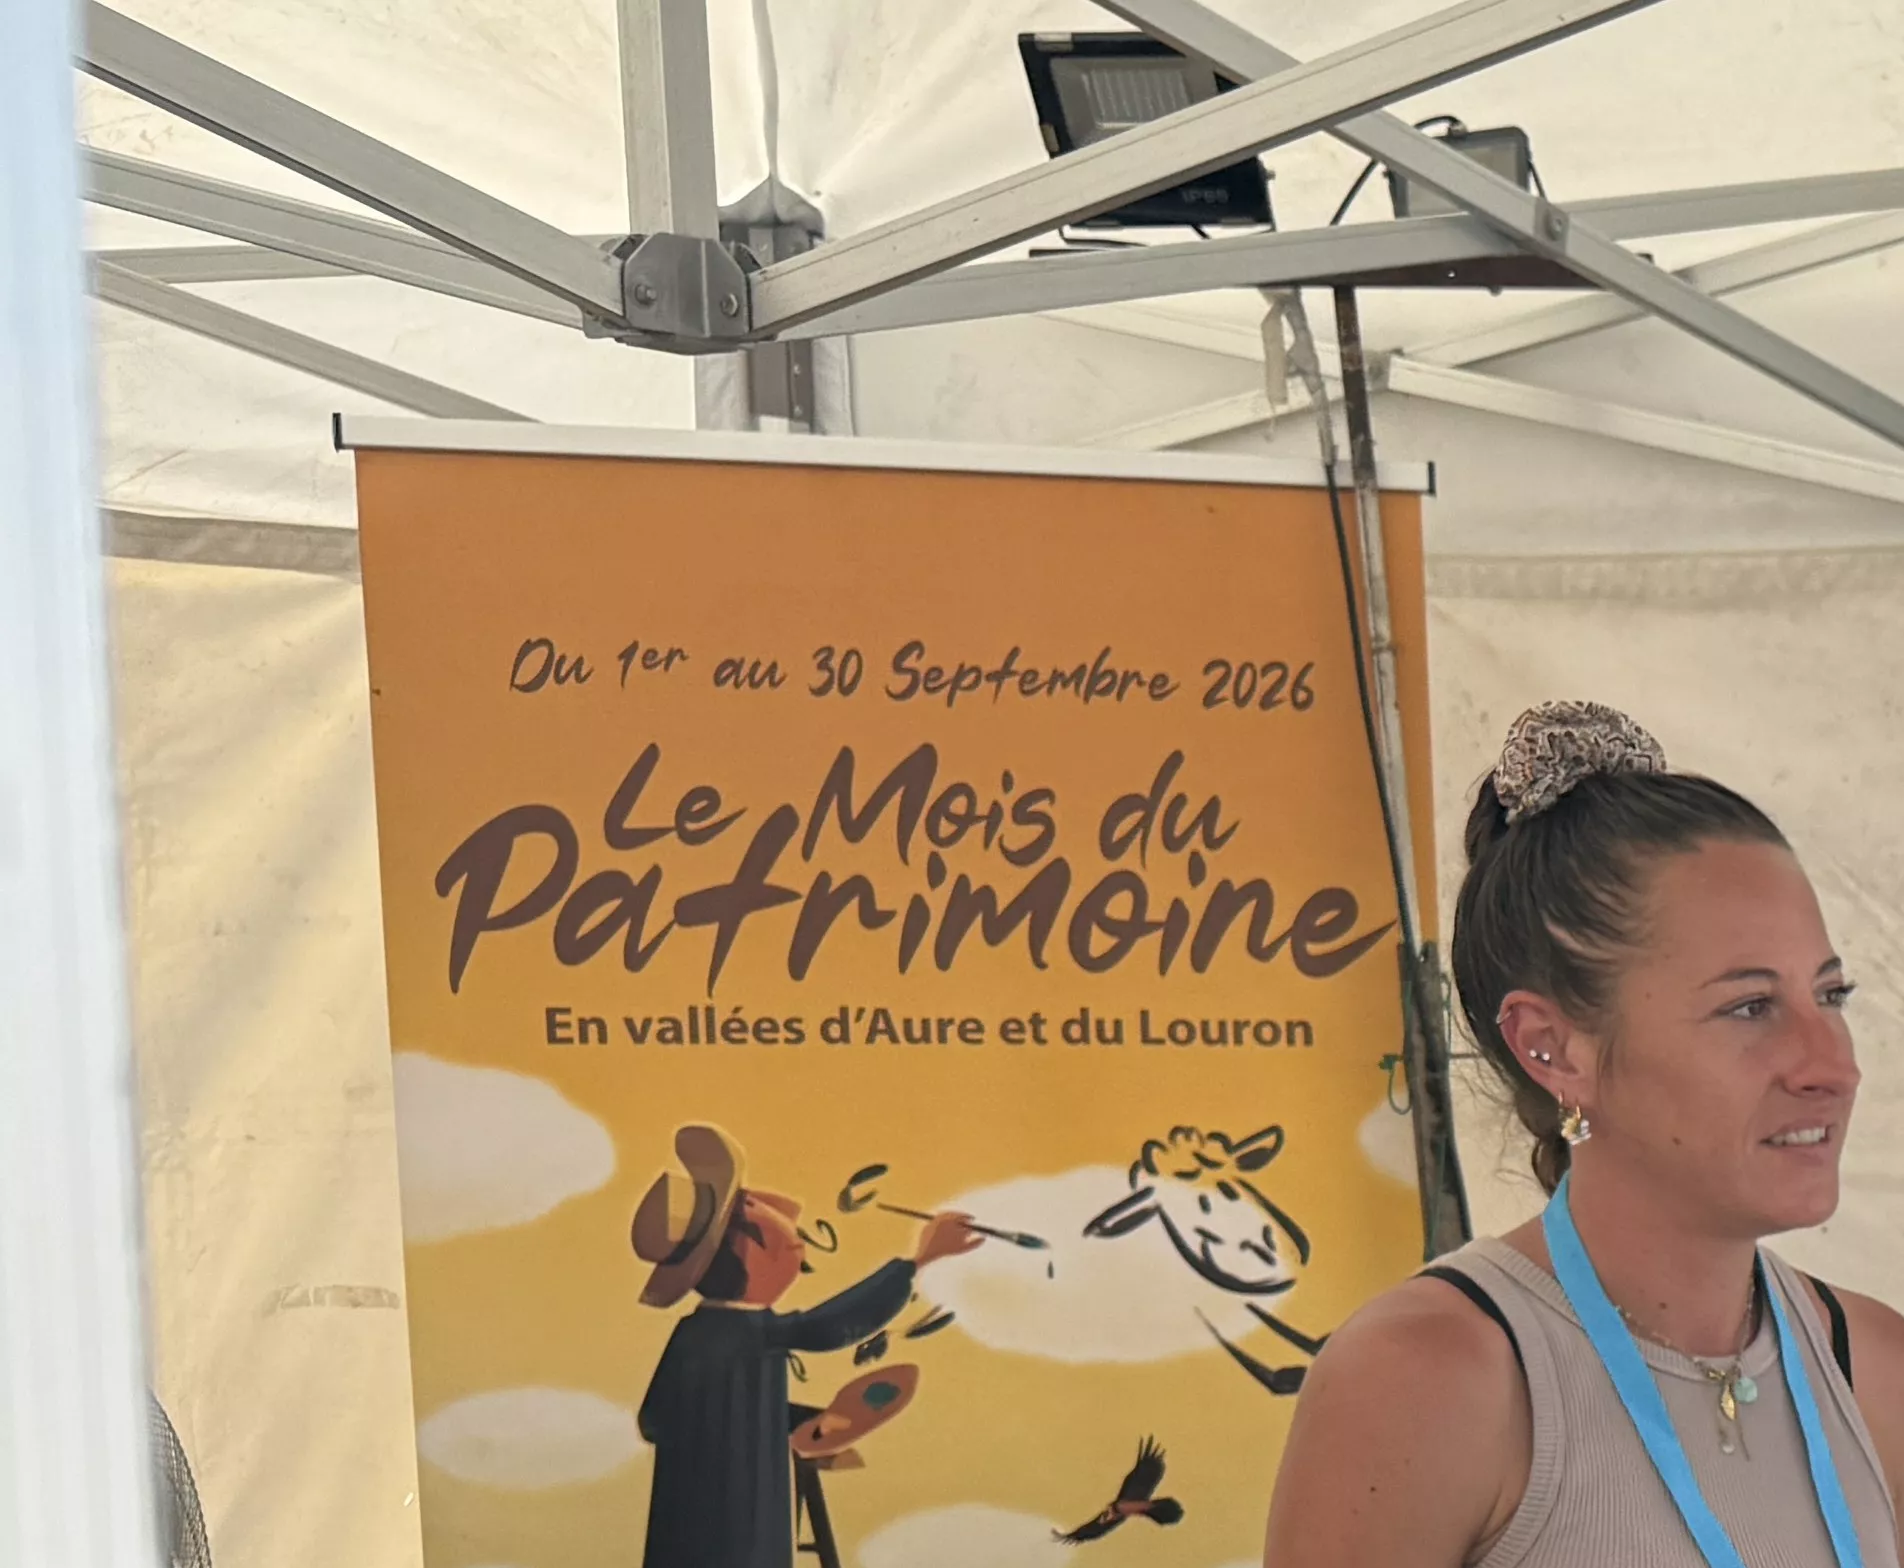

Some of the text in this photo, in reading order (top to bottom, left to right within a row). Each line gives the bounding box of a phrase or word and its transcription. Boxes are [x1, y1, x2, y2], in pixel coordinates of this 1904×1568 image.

[509, 637, 1316, 712] Du 1er au 30 Septembre 2026
[603, 741, 1239, 867] Le Mois du
[434, 801, 1399, 999] Patrimoine
[544, 1007, 608, 1047] En
[621, 1003, 806, 1047] vallées
[998, 1013, 1046, 1047] et
[1064, 1007, 1126, 1047] du
[1139, 1008, 1314, 1048] Louron
